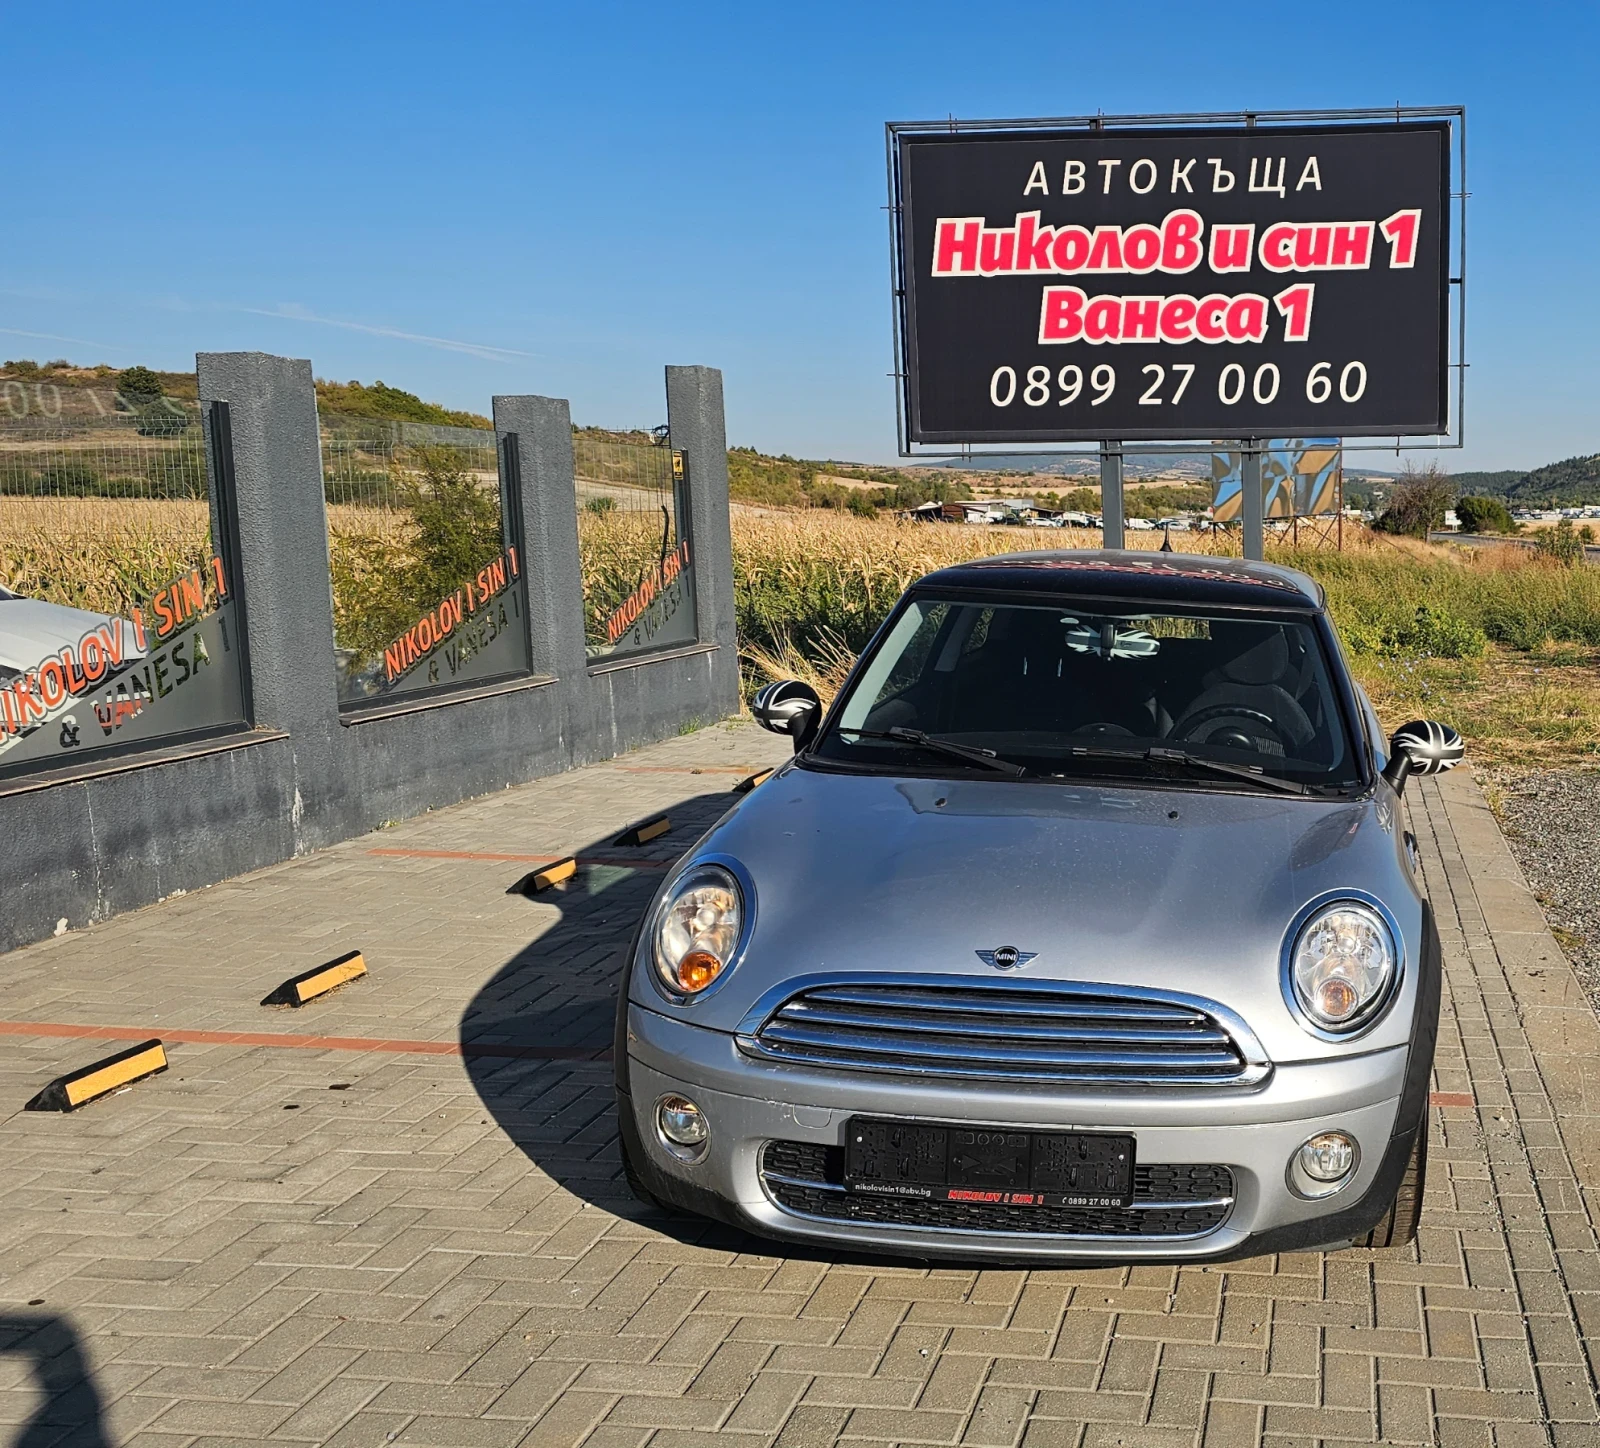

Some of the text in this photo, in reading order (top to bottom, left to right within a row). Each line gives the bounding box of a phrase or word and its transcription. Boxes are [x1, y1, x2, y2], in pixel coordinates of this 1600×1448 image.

[1023, 156, 1323, 198] АВТОКЪЩА
[934, 208, 1422, 276] Николов и син 1
[1040, 283, 1315, 344] Ванеса 1
[990, 360, 1367, 407] 0899 27 00 60
[383, 546, 518, 682] NIKOLOV I SIN 1
[607, 575, 654, 643] NIKOLOV
[663, 548, 681, 586] SIN
[0, 556, 226, 744] IKOLOV I SIN 1
[428, 660, 439, 683] &
[445, 603, 508, 676] VANESA
[60, 616, 231, 748] & VANESA 1
[996, 953, 1017, 961] MINI
[855, 1184, 931, 1197] nikolovisin1@abv.bg
[948, 1190, 1001, 1202] NIKOLOV
[1011, 1193, 1033, 1204] SIN
[1037, 1195, 1044, 1205] 1
[1068, 1197, 1121, 1206] 0899 27 00 60
